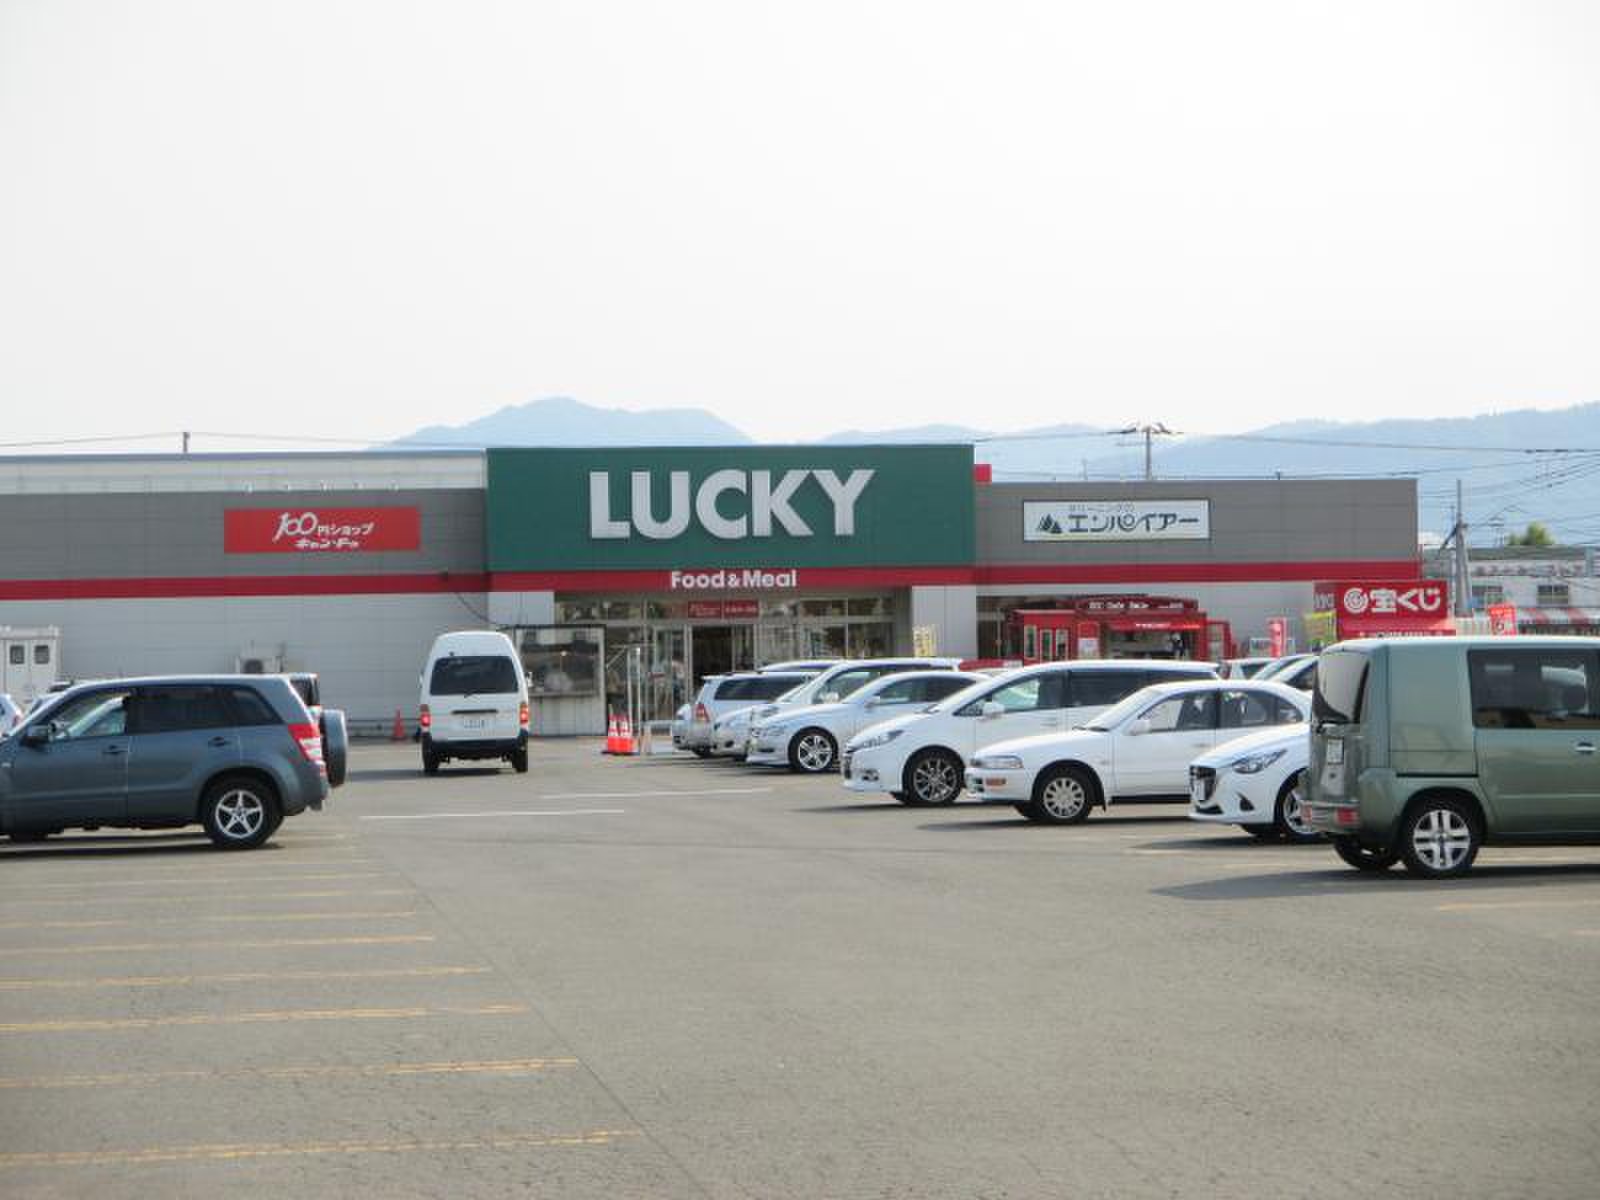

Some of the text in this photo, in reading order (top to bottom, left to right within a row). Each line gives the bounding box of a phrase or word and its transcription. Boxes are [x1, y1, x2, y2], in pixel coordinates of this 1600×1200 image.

[589, 469, 876, 540] LUCKY
[1068, 512, 1200, 534] エンパイアー
[1369, 586, 1442, 613] 宝くじ
